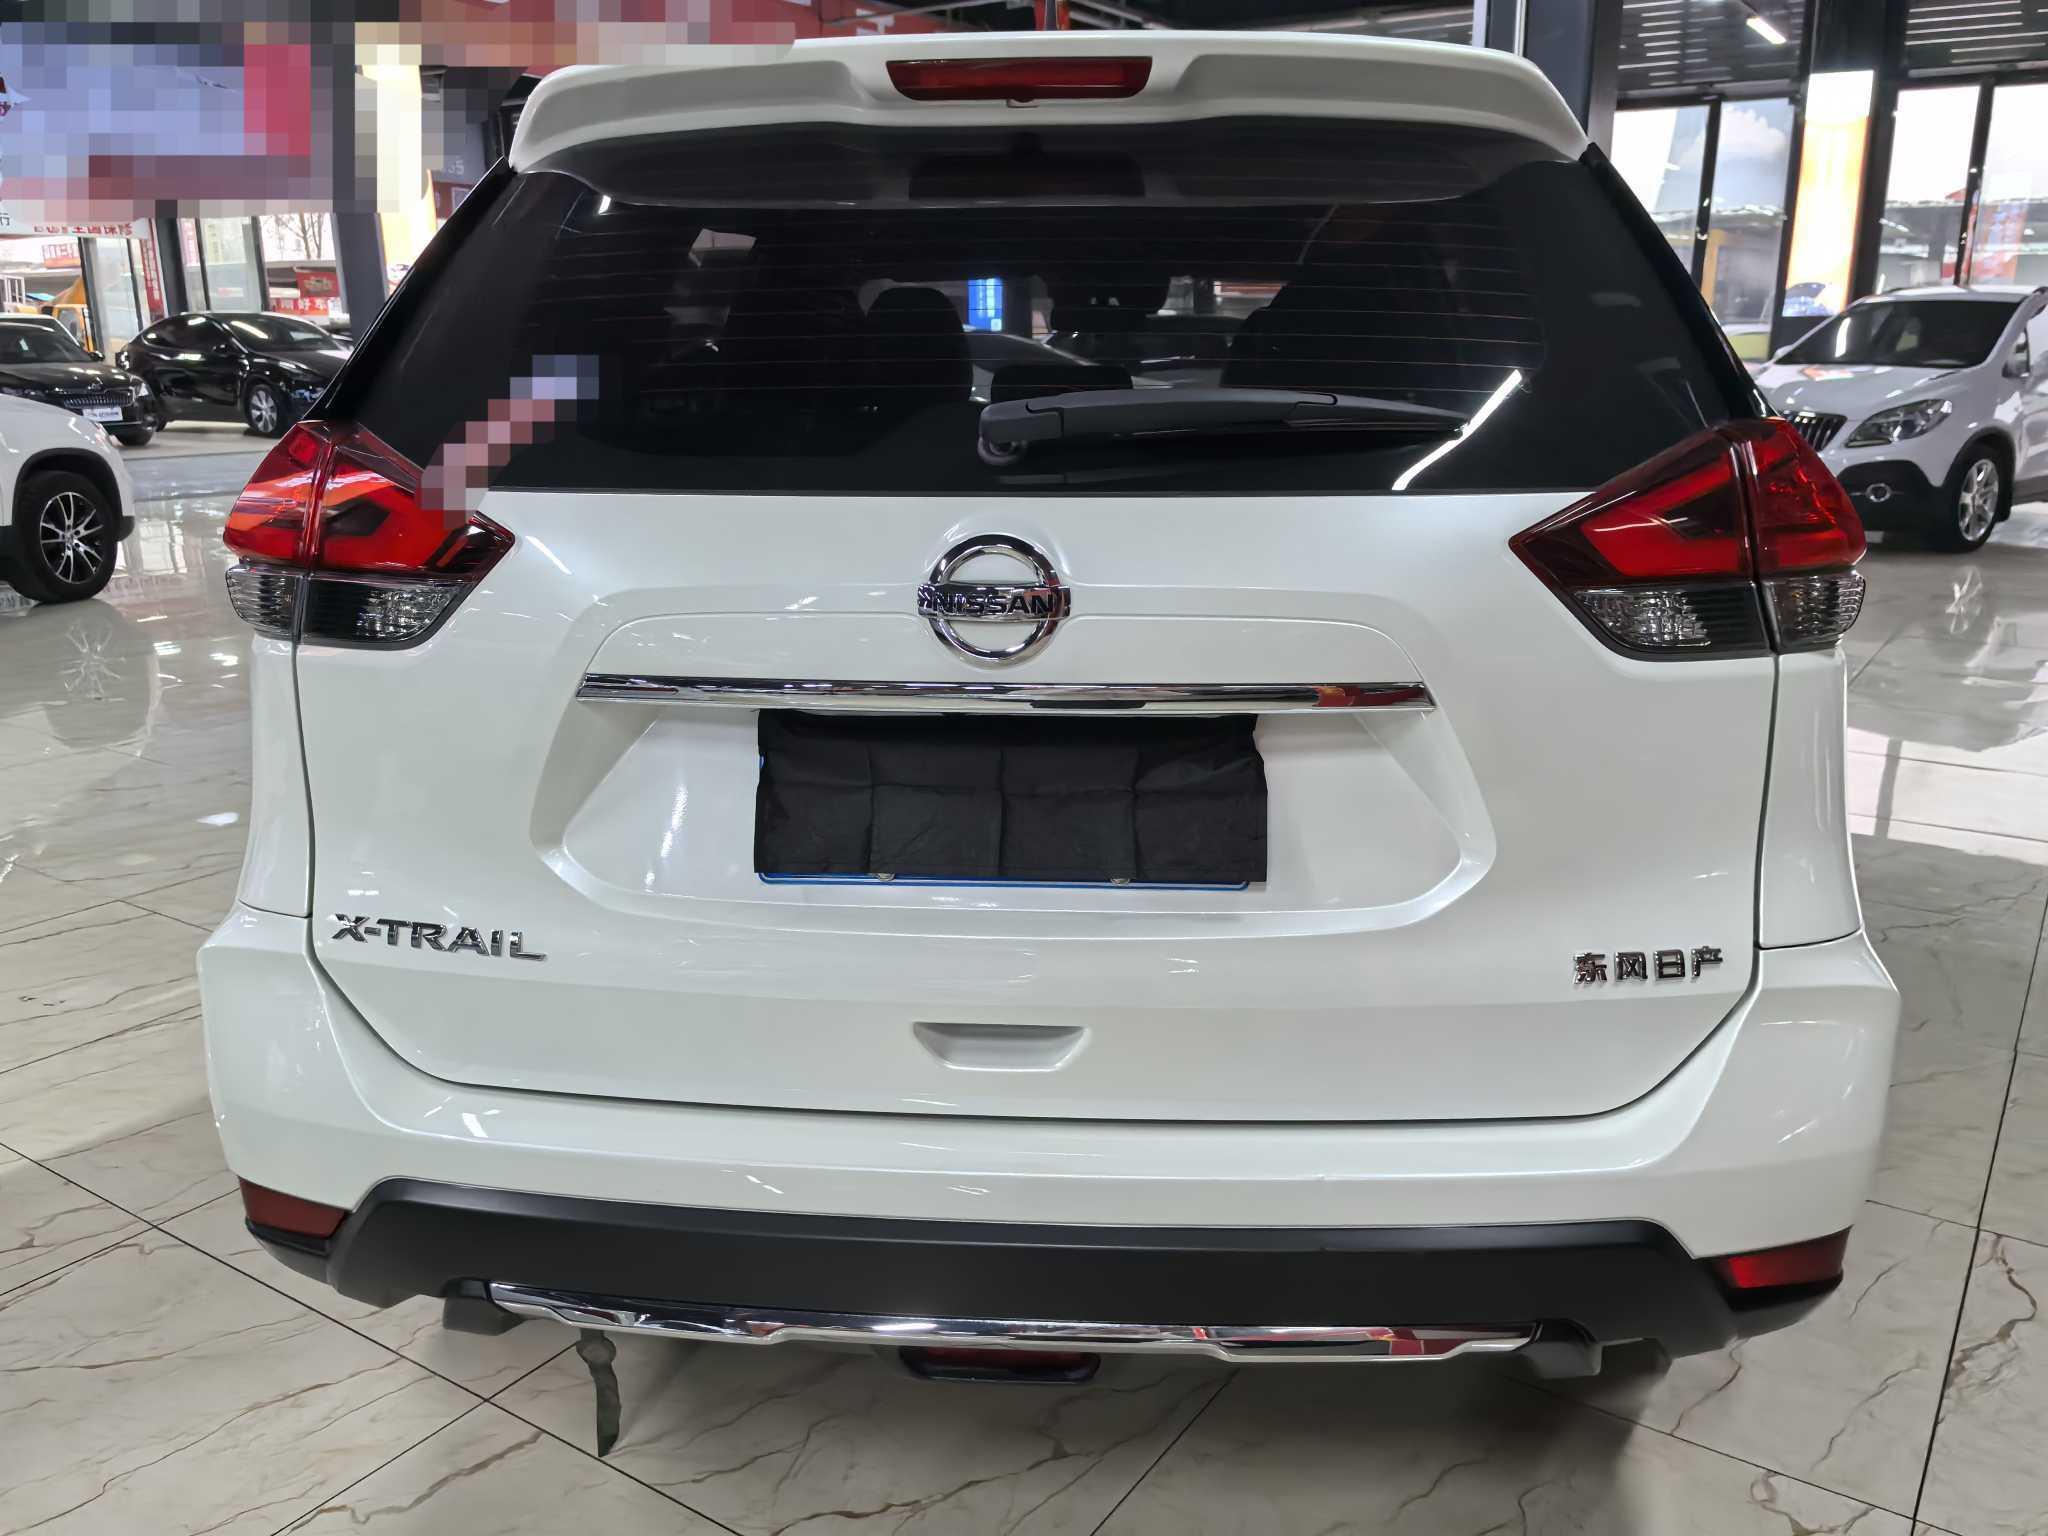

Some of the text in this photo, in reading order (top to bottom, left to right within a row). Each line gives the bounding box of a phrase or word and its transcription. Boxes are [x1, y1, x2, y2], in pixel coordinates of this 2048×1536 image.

[929, 588, 1056, 616] NISSAN
[331, 913, 547, 961] X-TRAIL
[1573, 946, 1723, 984] 东风日产
